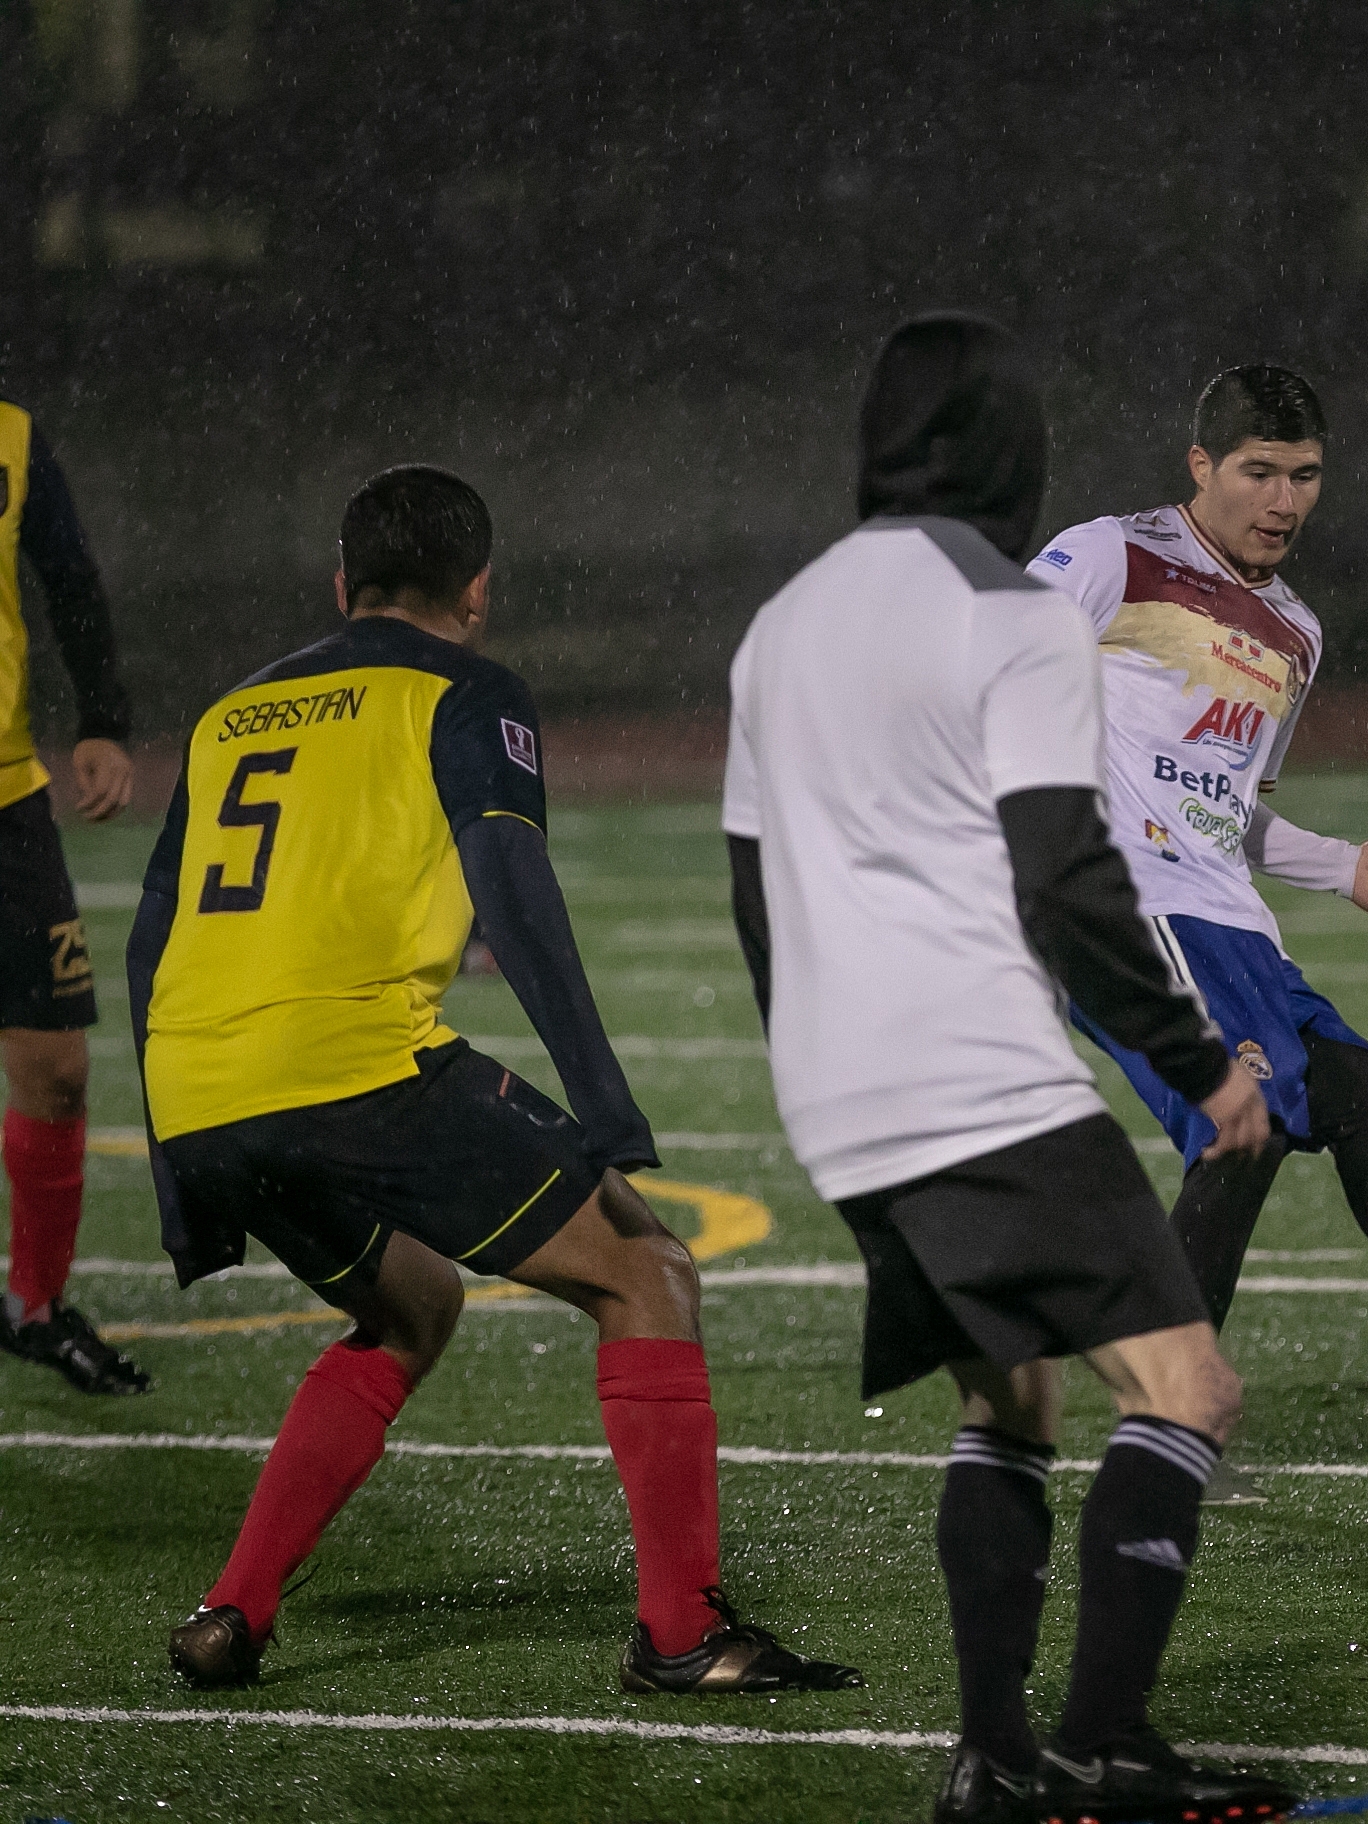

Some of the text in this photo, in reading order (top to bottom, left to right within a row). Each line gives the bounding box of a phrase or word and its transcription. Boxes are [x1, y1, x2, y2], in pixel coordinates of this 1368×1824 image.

[217, 686, 367, 743] SEBASTIAN
[1181, 697, 1265, 746] AKI
[196, 745, 300, 916] 5
